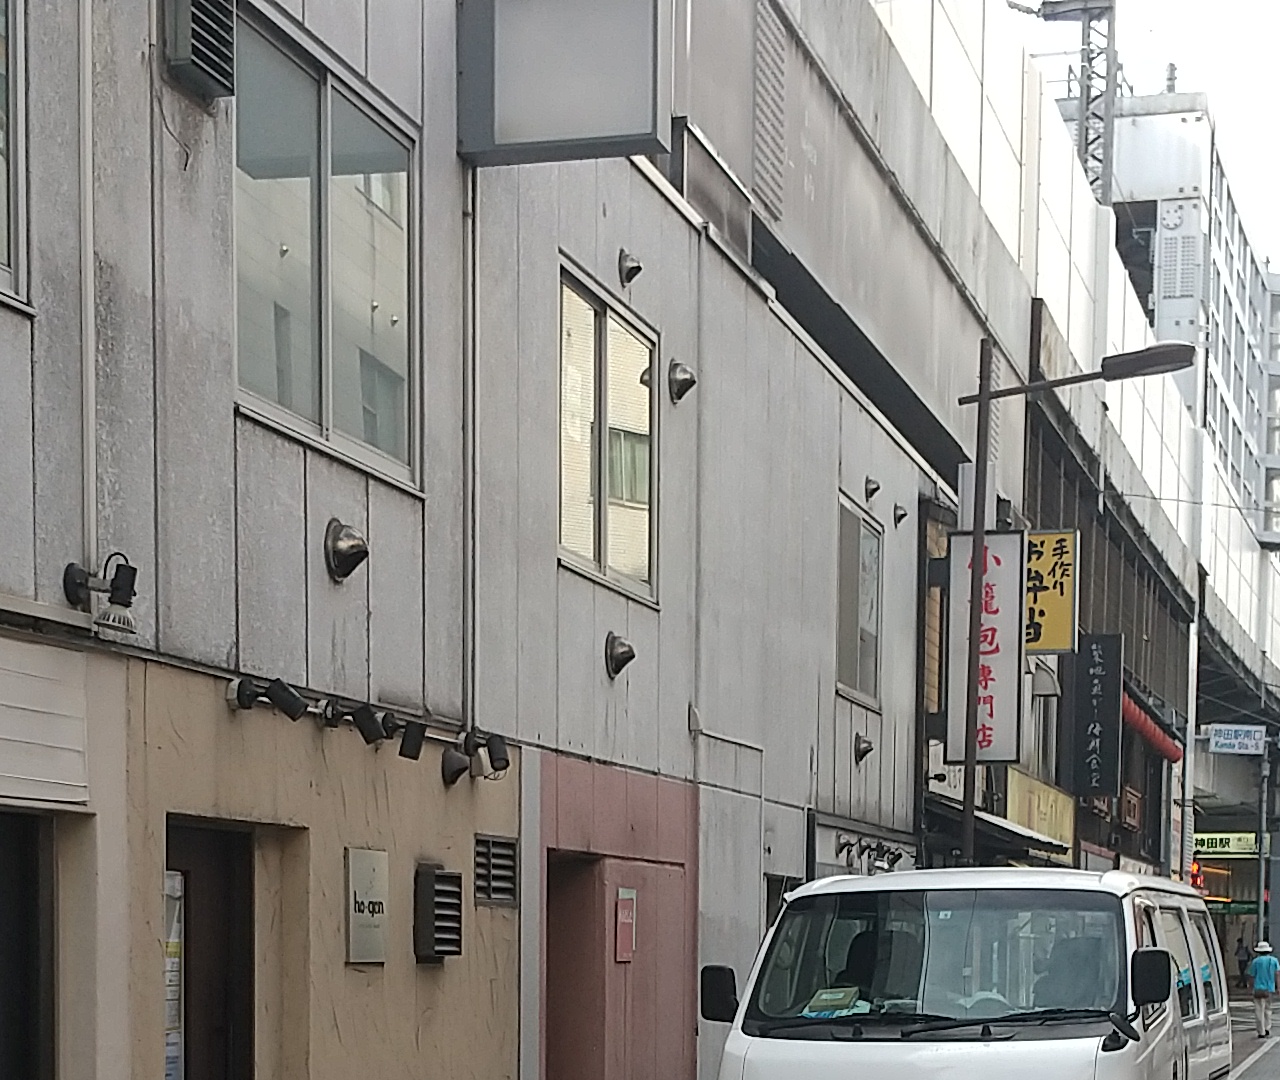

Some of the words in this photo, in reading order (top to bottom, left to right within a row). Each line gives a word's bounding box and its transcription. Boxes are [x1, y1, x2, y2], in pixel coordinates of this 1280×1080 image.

[1026, 539, 1050, 644] お弁当
[1047, 537, 1073, 597] 手作り
[1194, 837, 1231, 849] 神田駅
